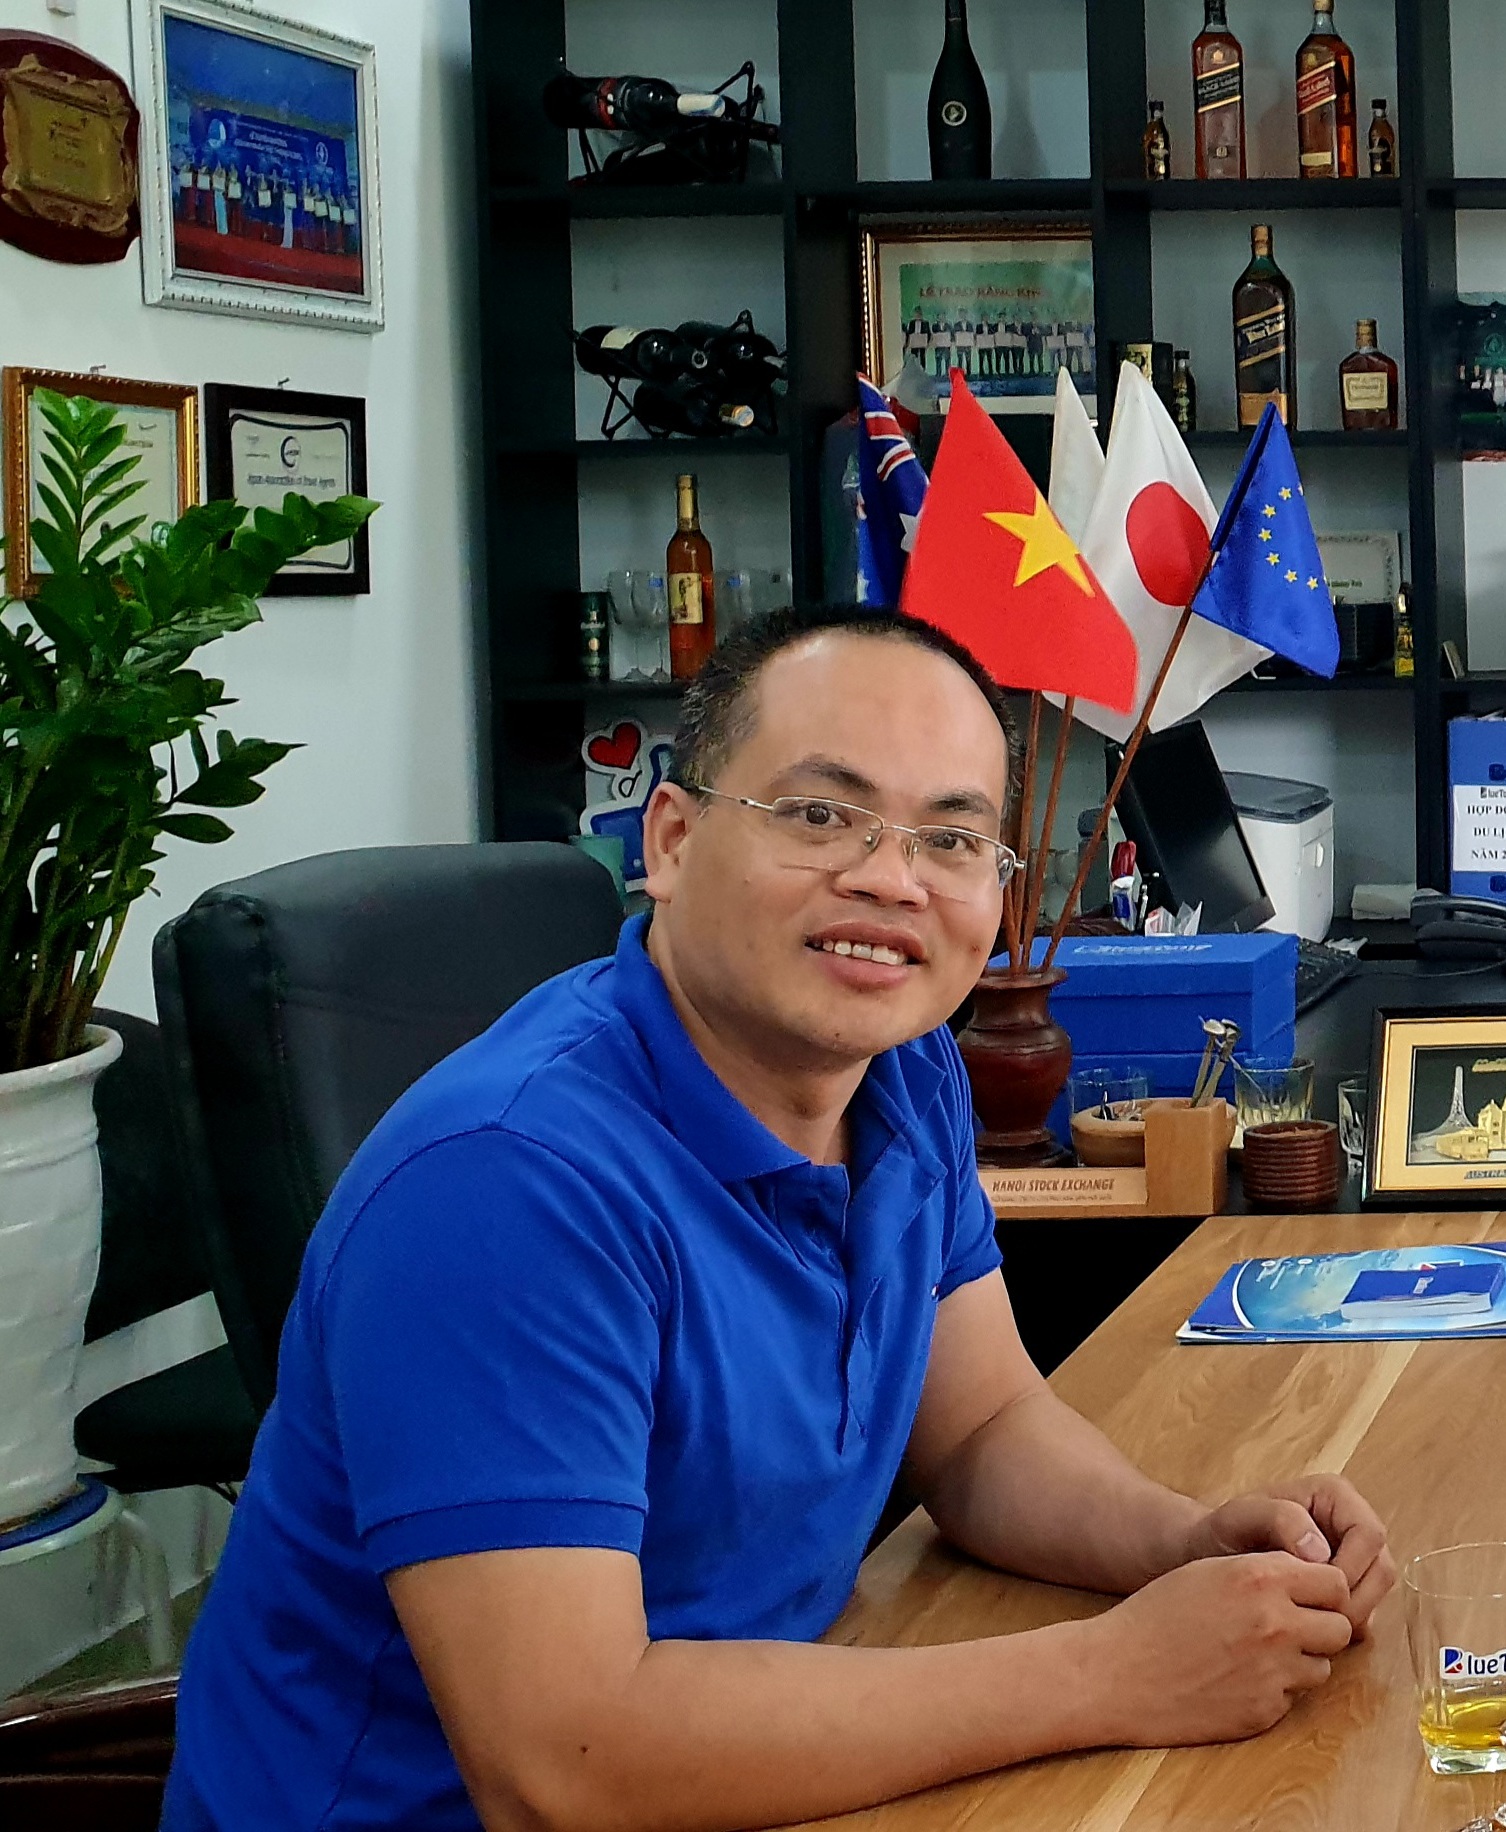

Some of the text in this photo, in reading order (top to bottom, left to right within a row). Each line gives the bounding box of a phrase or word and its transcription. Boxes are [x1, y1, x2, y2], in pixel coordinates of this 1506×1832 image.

[992, 1178, 1115, 1192] HANOI STOCK EXCHANGE
